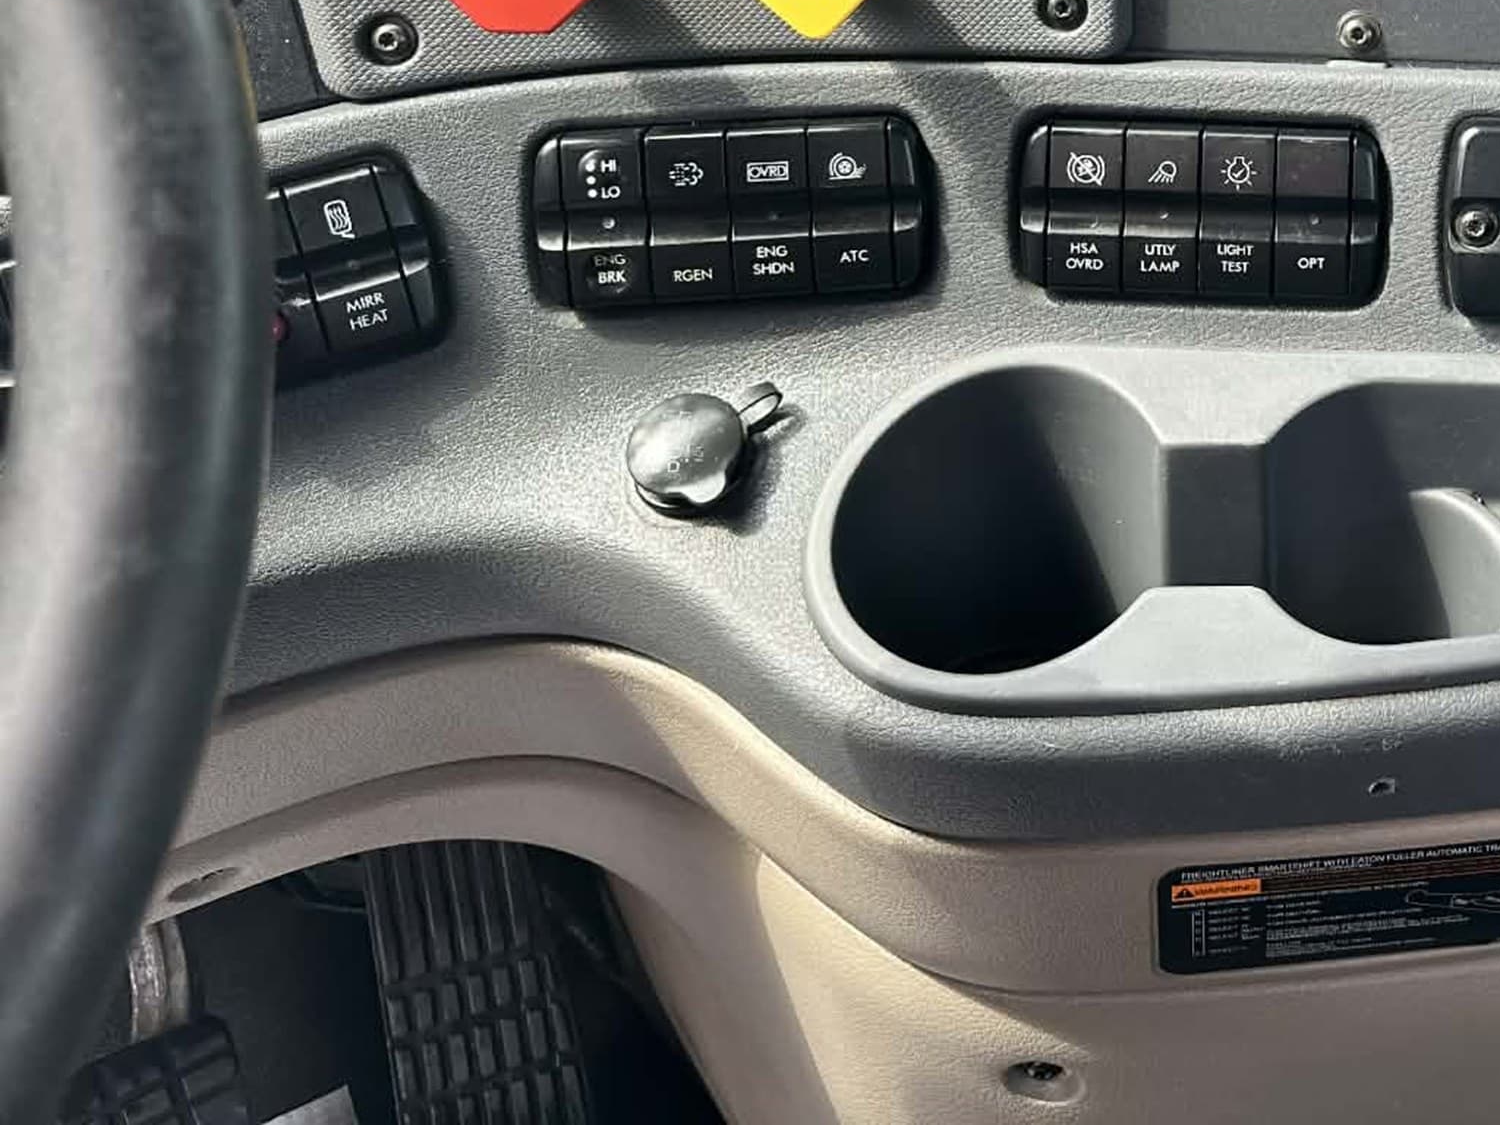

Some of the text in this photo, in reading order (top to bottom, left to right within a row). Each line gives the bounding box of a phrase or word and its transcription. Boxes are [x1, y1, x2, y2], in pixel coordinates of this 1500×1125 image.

[601, 160, 617, 173] HI
[749, 165, 787, 179] OVRD
[601, 186, 621, 199] LO
[756, 245, 788, 259] ENG
[839, 249, 869, 263] ATC
[1069, 243, 1099, 255] HSA
[1145, 244, 1177, 257] UTLY
[1217, 244, 1254, 257] LIGHT
[595, 253, 627, 266] ENG
[1065, 257, 1104, 271] OVRD
[1140, 260, 1181, 273] LAMP
[1297, 257, 1326, 270] OPT
[752, 261, 795, 276] SHDN
[1221, 261, 1250, 274] TEST
[598, 270, 627, 284] BRK
[674, 268, 714, 283] RGEN
[345, 292, 386, 313] MIRR
[349, 309, 389, 331] HEAT
[1387, 848, 1425, 861] FULLER
[1426, 845, 1483, 858] AUTOMATIC
